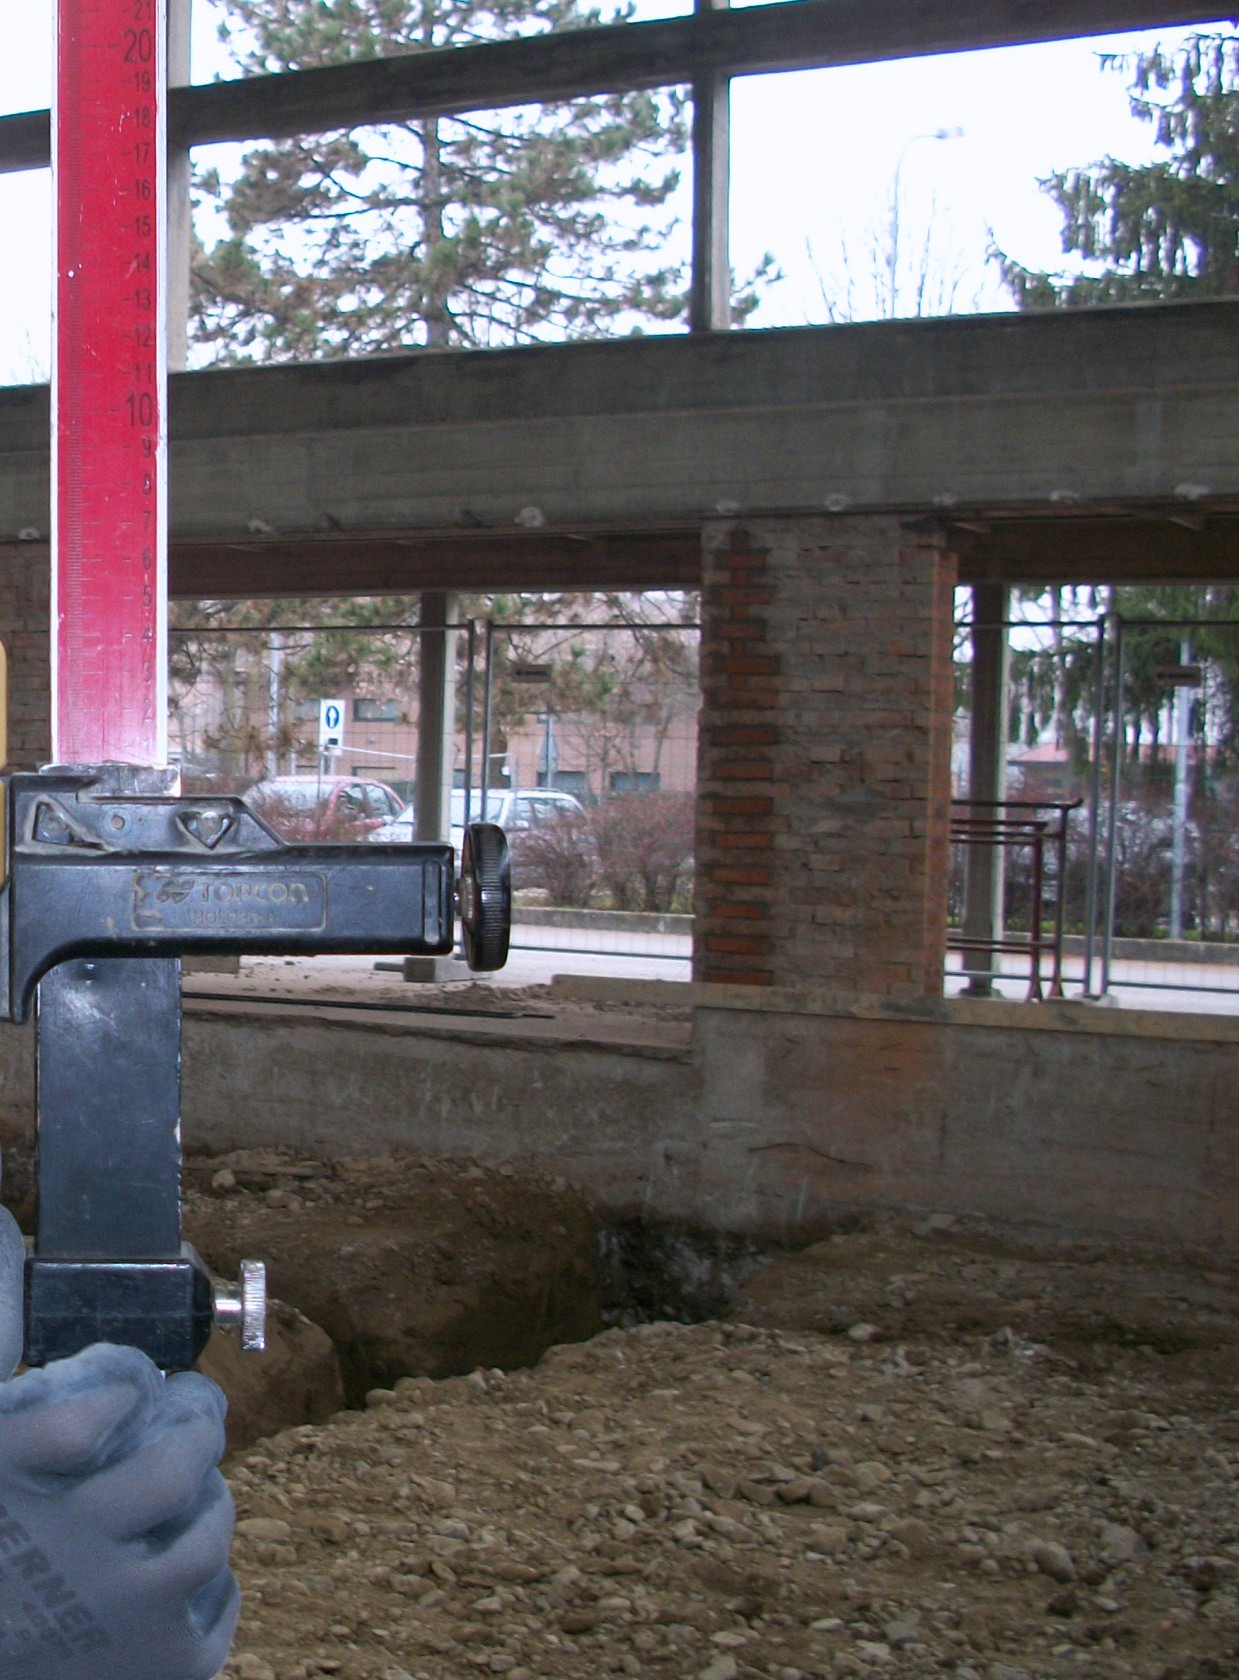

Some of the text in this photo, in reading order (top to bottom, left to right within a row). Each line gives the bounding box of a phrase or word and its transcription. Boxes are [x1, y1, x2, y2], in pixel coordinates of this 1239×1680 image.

[123, 28, 152, 63] 20
[133, 71, 151, 91] 19
[133, 106, 151, 128] 18
[133, 143, 151, 165] 17
[133, 179, 151, 201] 16
[133, 216, 152, 238] 15
[133, 253, 151, 272] 14
[133, 290, 151, 311] 13
[133, 327, 151, 348] 12
[134, 363, 151, 384] 11
[126, 392, 153, 427] 10
[142, 436, 152, 457] 9
[142, 511, 152, 533] 7
[142, 549, 152, 571] 6
[142, 586, 152, 608] 5
[142, 624, 152, 645] 4
